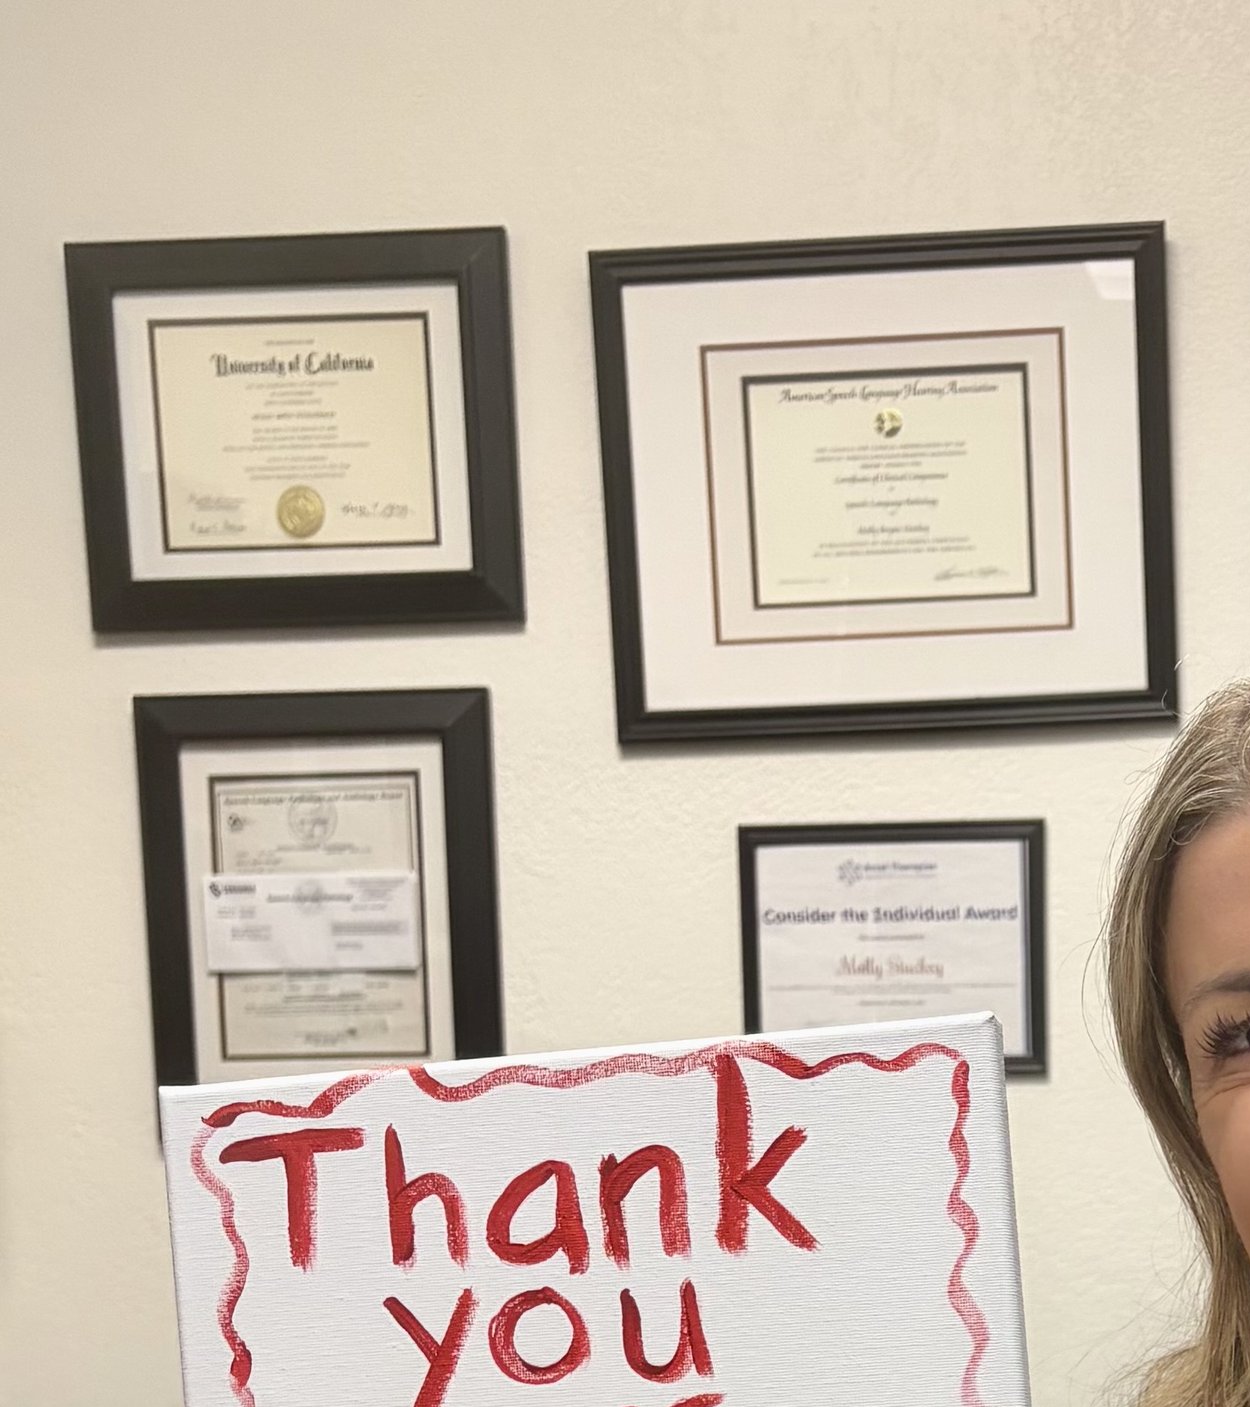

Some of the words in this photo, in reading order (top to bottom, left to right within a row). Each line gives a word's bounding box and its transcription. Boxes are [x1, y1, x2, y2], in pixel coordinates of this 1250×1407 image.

[209, 353, 286, 378] University
[288, 353, 300, 374] of
[303, 351, 374, 375] California
[763, 907, 836, 925] Consider
[840, 906, 868, 923] the
[873, 904, 960, 922] Individual
[963, 904, 1018, 921] Award
[219, 1053, 820, 1274] Thank
